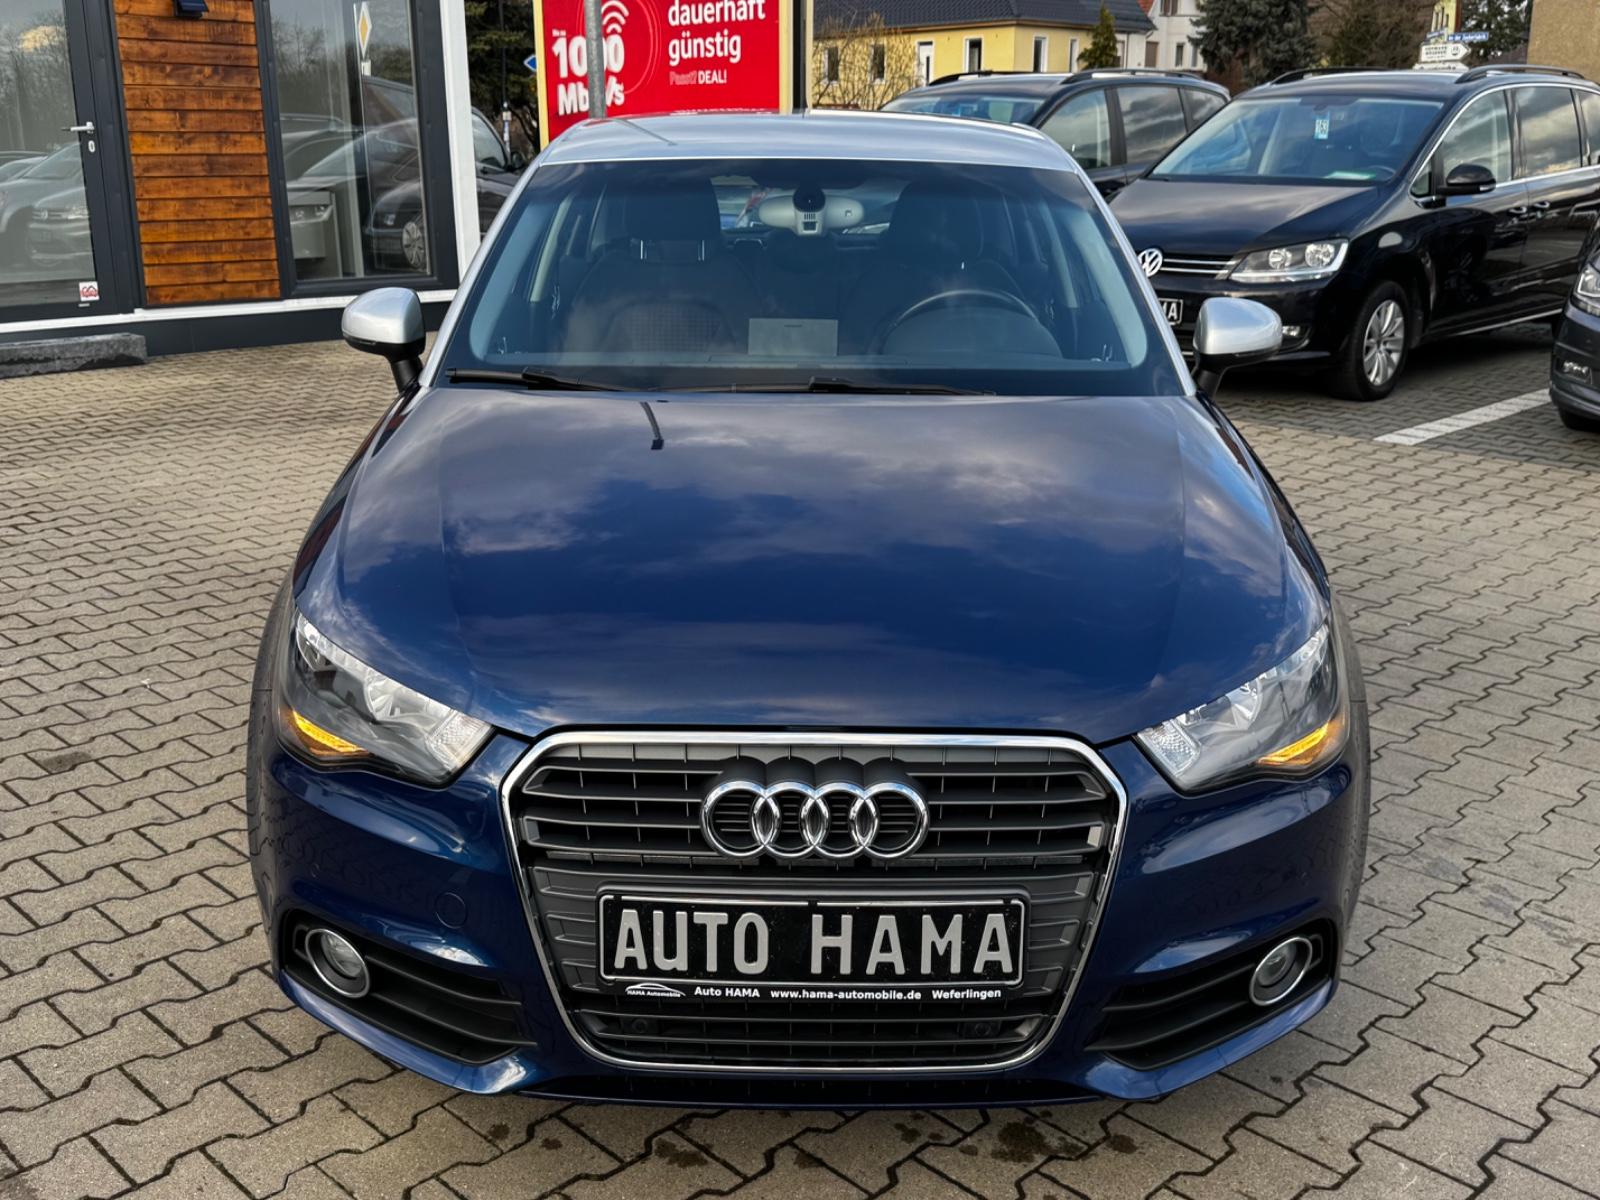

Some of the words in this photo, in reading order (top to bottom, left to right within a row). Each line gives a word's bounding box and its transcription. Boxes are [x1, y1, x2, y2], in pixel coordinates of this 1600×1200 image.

[667, 0, 766, 27] dauerhaft
[668, 28, 742, 67] günstig
[698, 68, 727, 85] DEAL!
[613, 908, 770, 975] AUTO
[810, 913, 1014, 975] HAMA
[694, 986, 723, 997] Auto
[725, 987, 761, 998] HAMA
[770, 989, 922, 1000] www.hama-automobile.de
[931, 989, 1002, 1001] Weferlingen
